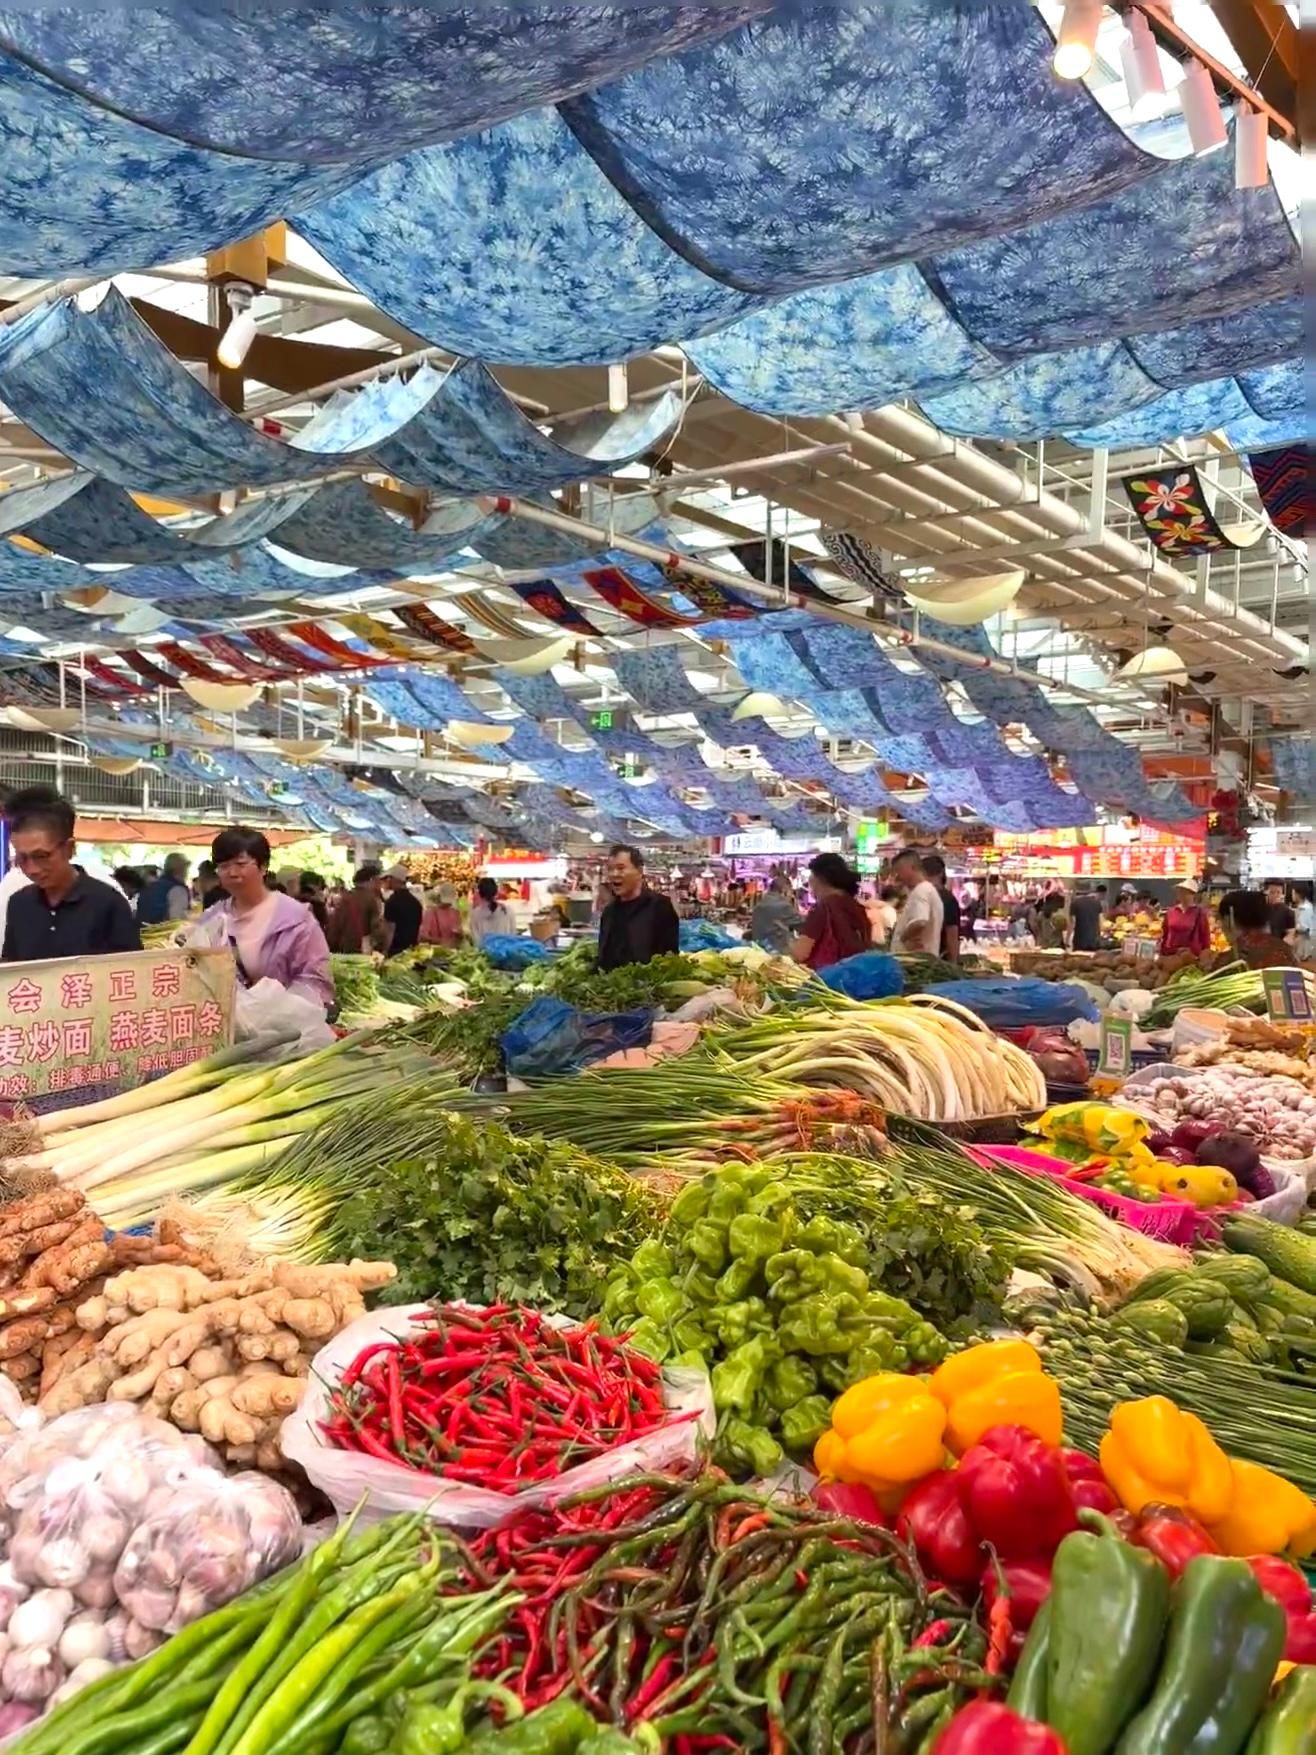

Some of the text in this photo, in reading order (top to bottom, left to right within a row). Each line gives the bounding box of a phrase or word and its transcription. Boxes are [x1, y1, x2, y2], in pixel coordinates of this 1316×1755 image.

[8, 963, 181, 1013] 会泽正宗
[110, 999, 225, 1052] 燕麦面条
